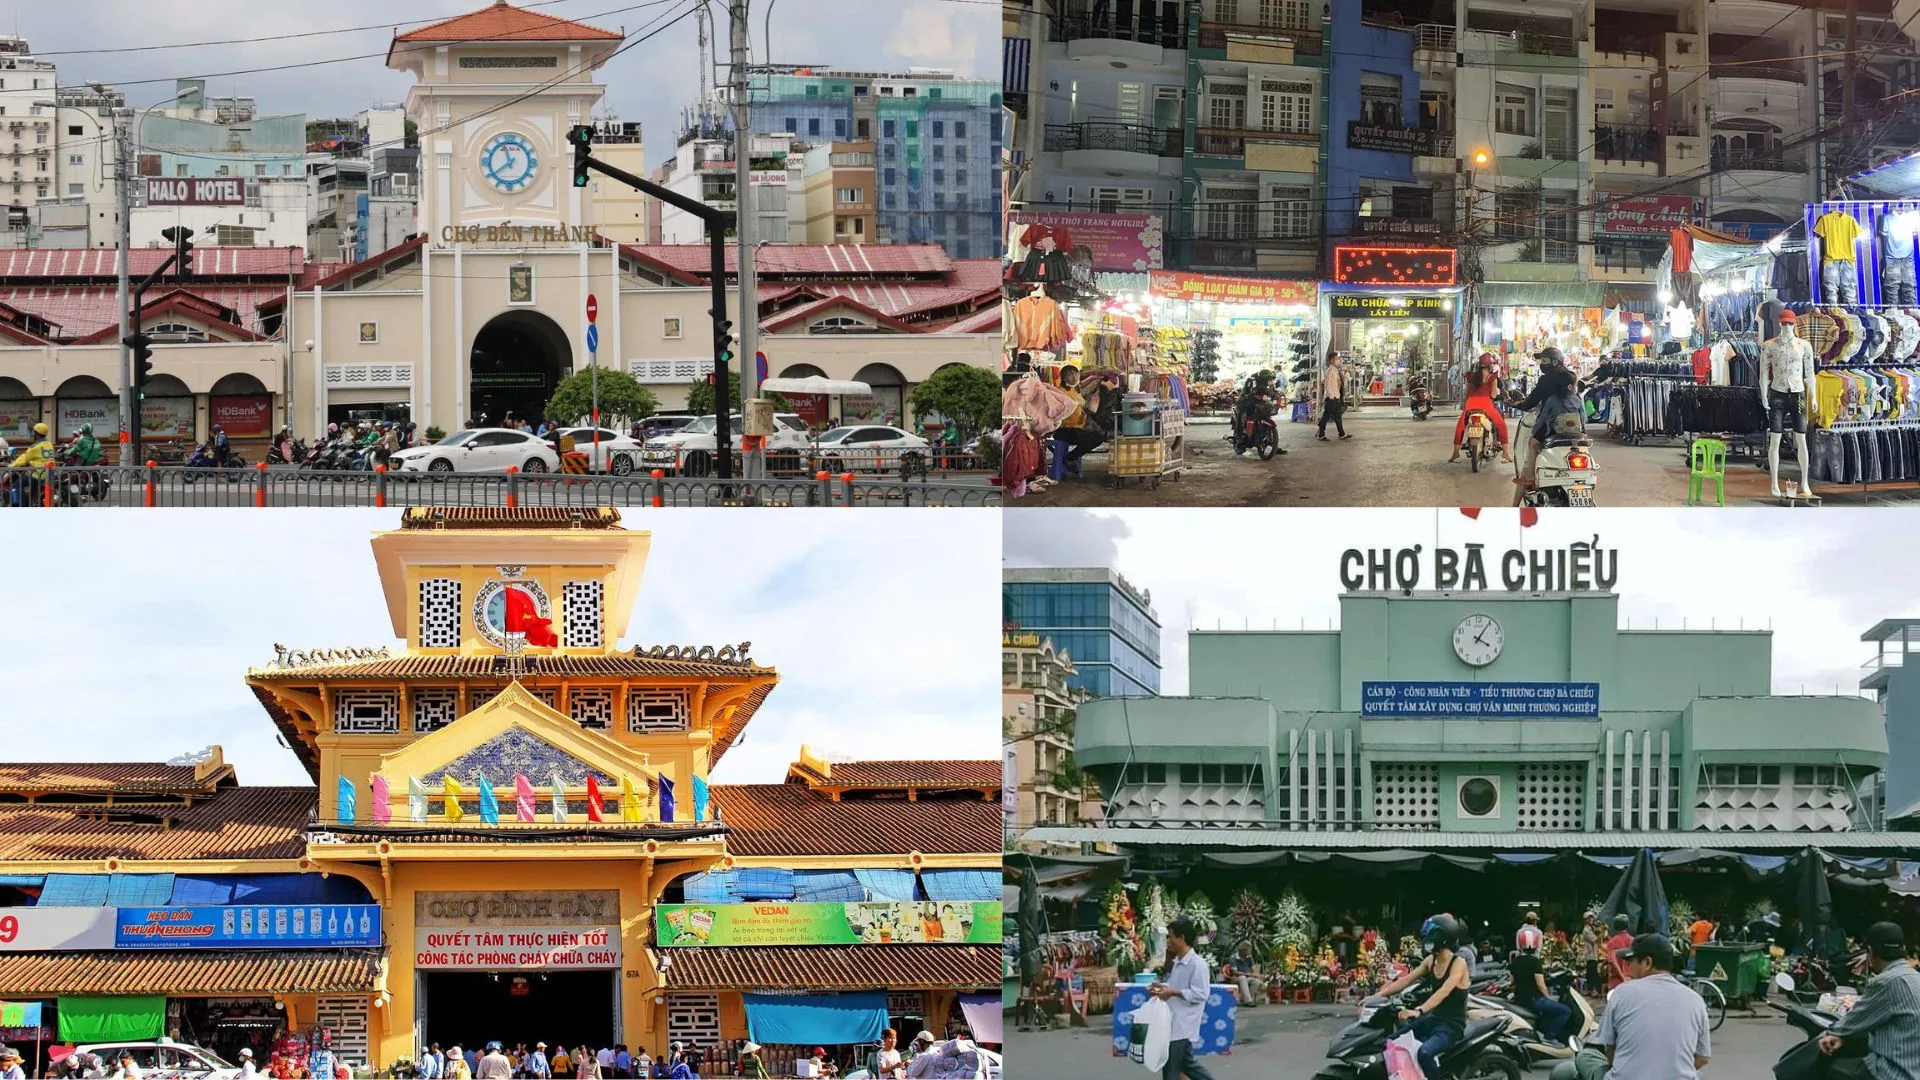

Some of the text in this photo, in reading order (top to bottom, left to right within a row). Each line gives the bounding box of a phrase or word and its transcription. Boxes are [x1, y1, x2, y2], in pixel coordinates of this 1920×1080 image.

[1417, 131, 1426, 143] 2
[149, 181, 242, 201] HALO HOTEL
[1083, 217, 1109, 226] TRANG
[1111, 219, 1145, 228] HOTGIRL
[441, 220, 598, 244] CHỢ BẾN THÀNH
[1227, 282, 1249, 296] GIẢM
[1250, 284, 1263, 297] GIÁ
[1417, 296, 1441, 307] KÍNH
[64, 409, 106, 419] HDBank
[217, 407, 257, 416] HDBank
[1340, 543, 1422, 597] CHỢ
[1367, 685, 1383, 697] CÁN
[1385, 686, 1396, 698] BỘ
[1404, 686, 1426, 697] CÔNG
[1427, 686, 1450, 697] NHÂN
[1451, 686, 1471, 697] VIÊN
[1501, 687, 1536, 698] THƯƠNG
[1537, 688, 1556, 699] CHỢ
[1557, 686, 1568, 698] BÀ
[1365, 698, 1395, 713] QUYẾT
[1398, 700, 1417, 712] TÂM
[1418, 700, 1437, 712] XÂY
[1464, 702, 1482, 714] CHỢ
[1483, 700, 1501, 713] VĂN
[1502, 703, 1526, 713] MINH
[1528, 702, 1561, 713] THƯƠNG
[1562, 702, 1597, 715] NGHIỆP
[147, 908, 193, 921] KEO DÁN
[429, 893, 606, 923] CHỢ BÌNH TÂY
[754, 906, 789, 915] VEDAN
[427, 928, 608, 949] QUYẾT TÂM THỰC HIỆN TỐT
[417, 949, 617, 965] CÔNG TÁC PHÒNG CHÁY CHỮA CHÁY
